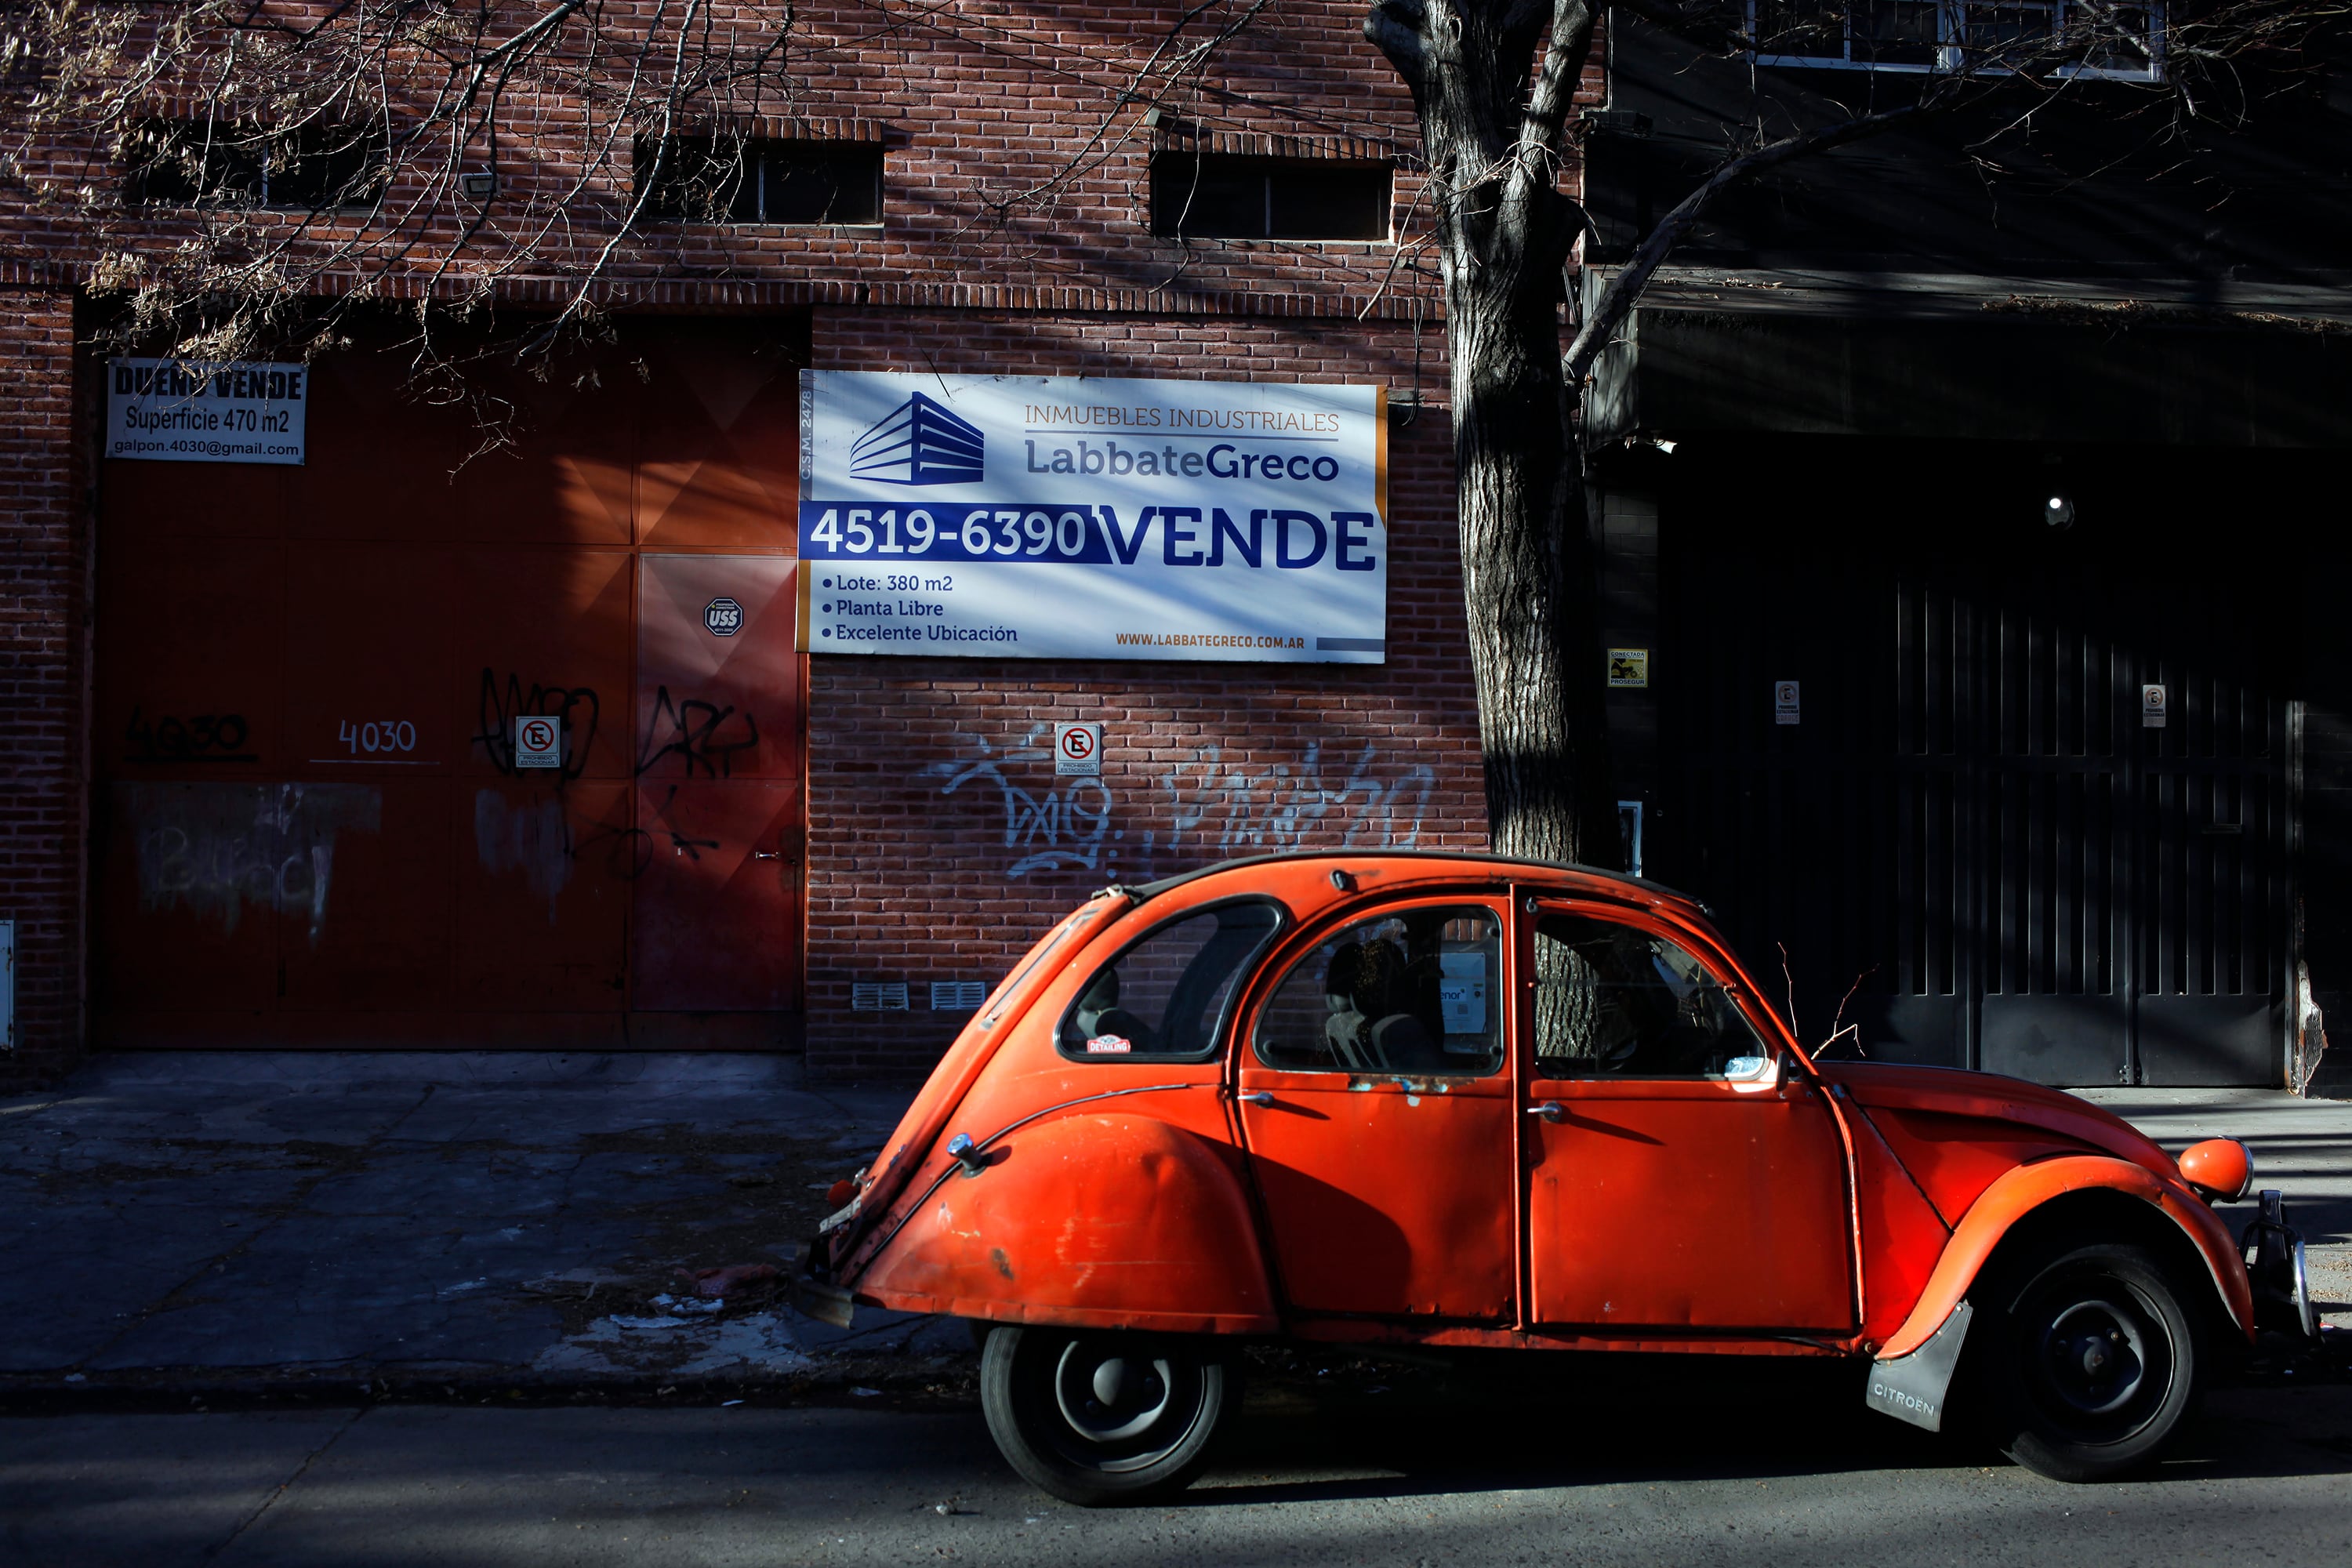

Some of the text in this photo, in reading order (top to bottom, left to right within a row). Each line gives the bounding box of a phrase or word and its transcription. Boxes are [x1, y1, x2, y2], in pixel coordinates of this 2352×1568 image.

[215, 370, 301, 400] VENDE
[126, 405, 289, 434] Superficie 470 m2
[1025, 405, 1339, 432] INMUEBLES INDUSTRIALES
[114, 438, 299, 456] galpon.4030@gmail.com
[801, 390, 811, 480] C.S.M. 2478
[1025, 439, 1340, 481] LabbateGreco
[811, 508, 1086, 557] 4519-6390
[1099, 505, 1377, 571] VENDE
[837, 575, 953, 591] Lote: 380 m2
[709, 610, 739, 626] USS
[837, 600, 944, 616] Planta Libre
[836, 624, 1018, 641] Excelente Ubicación
[1116, 633, 1305, 649] WWW.LABBATEGRECO.COM.AR
[339, 719, 416, 754] 4030
[1090, 1042, 1127, 1052] DETAILING
[1874, 1383, 1935, 1417] CITROËN
